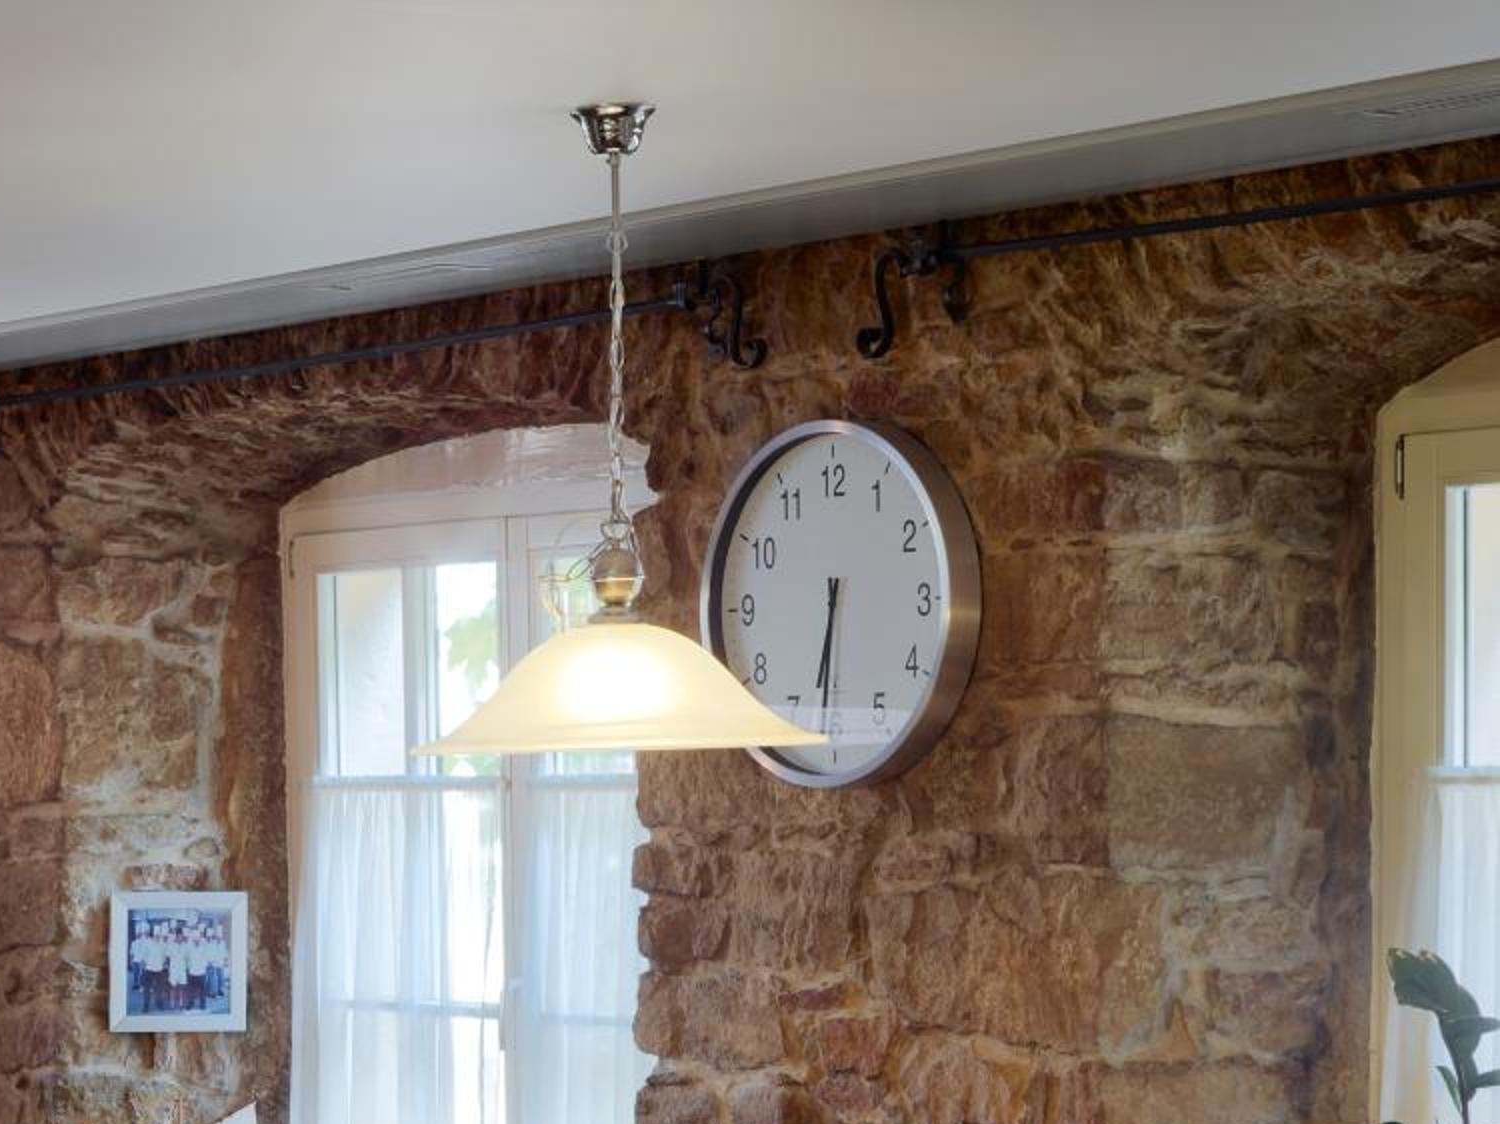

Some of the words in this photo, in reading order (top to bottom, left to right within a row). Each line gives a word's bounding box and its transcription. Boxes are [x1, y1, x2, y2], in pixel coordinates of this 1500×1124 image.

[821, 463, 846, 497] 12
[872, 480, 881, 512] 1
[781, 489, 801, 520] 11
[902, 520, 917, 553] 2
[752, 538, 775, 569] 10
[741, 595, 755, 626] 9
[917, 583, 932, 616] 3
[754, 653, 767, 685] 8
[905, 645, 919, 678] 4
[873, 692, 886, 724] 5
